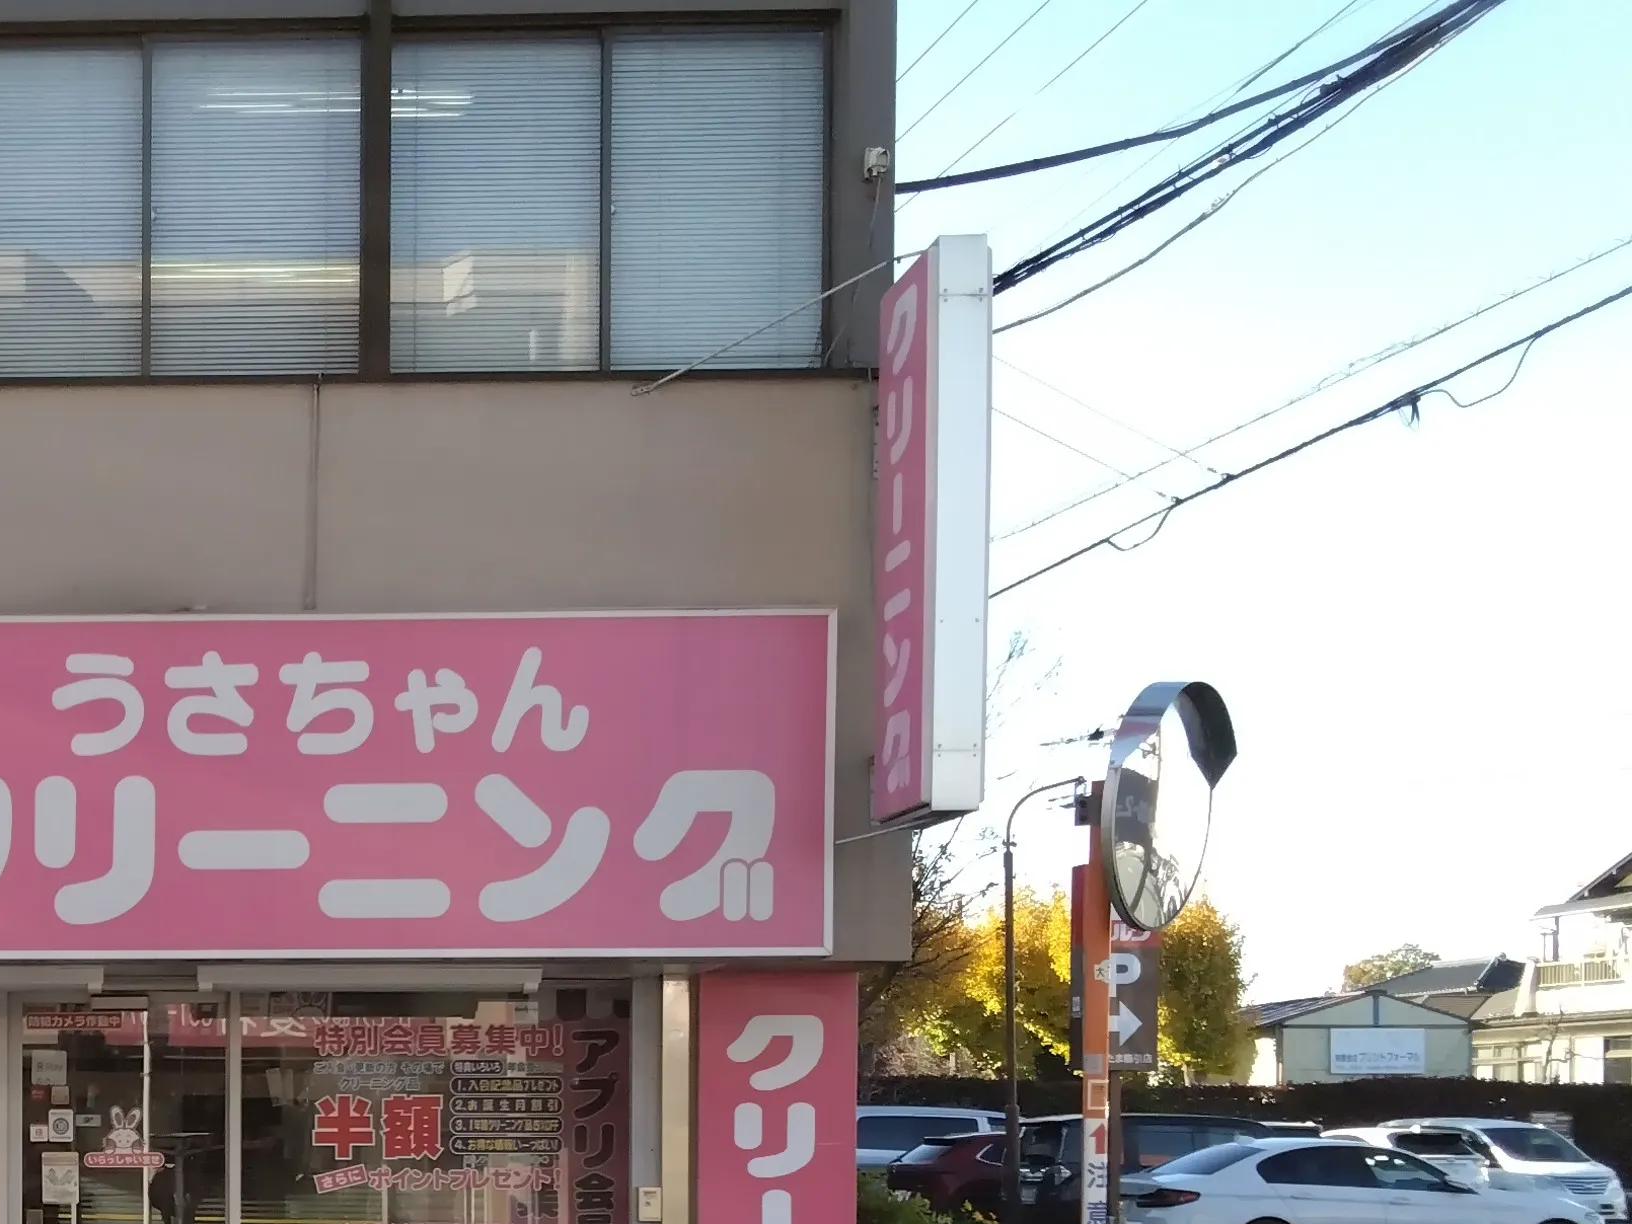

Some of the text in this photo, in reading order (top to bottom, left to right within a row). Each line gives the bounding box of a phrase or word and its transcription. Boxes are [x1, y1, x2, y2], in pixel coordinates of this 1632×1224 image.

[883, 283, 918, 793] クリーニング
[52, 646, 589, 757] うさちゃん
[313, 1023, 564, 1056] 特別会員募集中!
[312, 1093, 444, 1160] 半額
[88, 1154, 160, 1165] いらっしゃいませ
[320, 1168, 363, 1187] さらに
